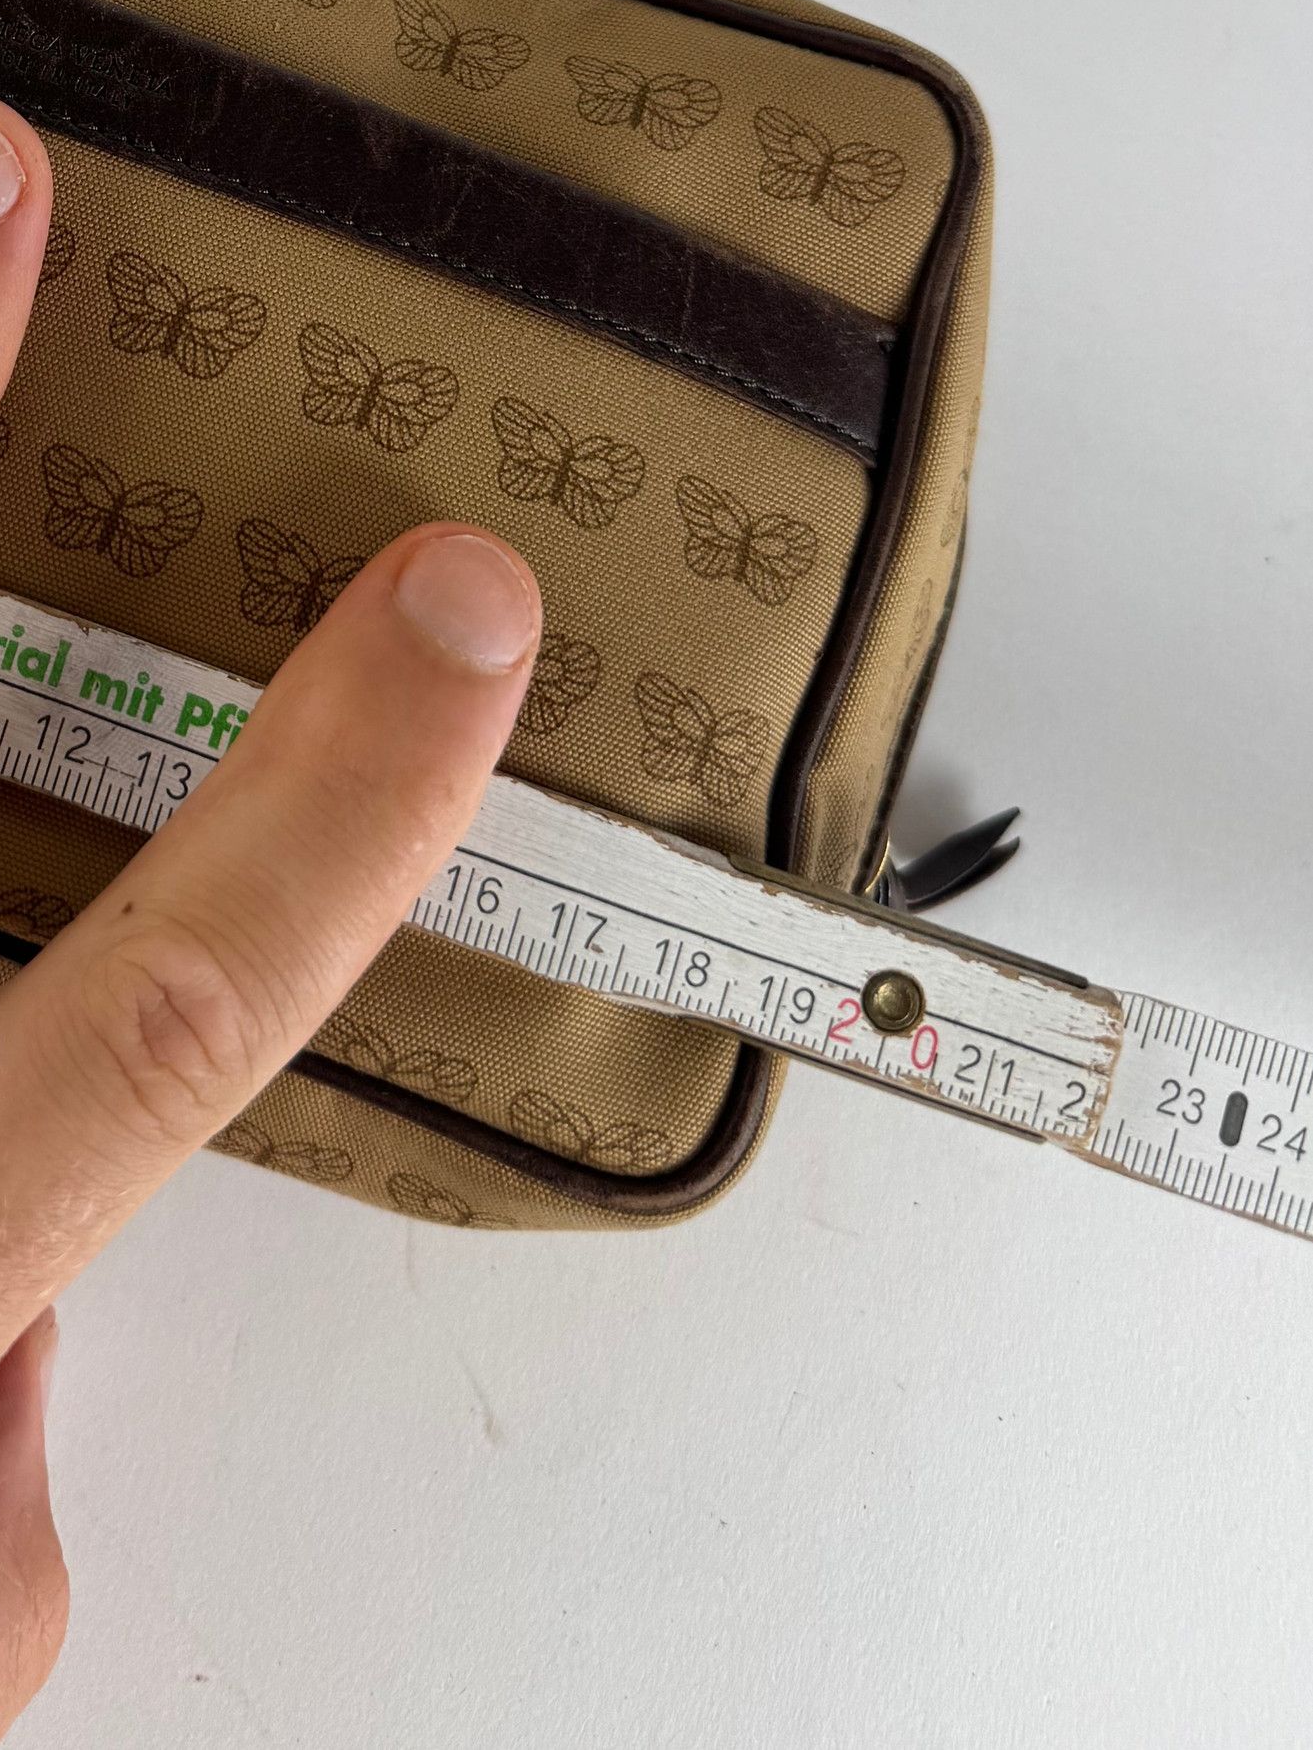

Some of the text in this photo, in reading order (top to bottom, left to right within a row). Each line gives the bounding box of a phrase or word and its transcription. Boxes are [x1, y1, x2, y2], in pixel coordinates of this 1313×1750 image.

[80, 669, 166, 724] mit
[174, 691, 250, 753] Pfi
[37, 714, 93, 765] 12
[137, 751, 192, 801] 13
[446, 864, 504, 914] 16
[551, 901, 608, 950] 17
[654, 938, 712, 988] 18
[759, 974, 817, 1024] 19
[953, 1043, 1016, 1096] 21
[1058, 1080, 1087, 1122] 2
[1156, 1078, 1206, 1125] 23
[1257, 1113, 1308, 1163] 24
